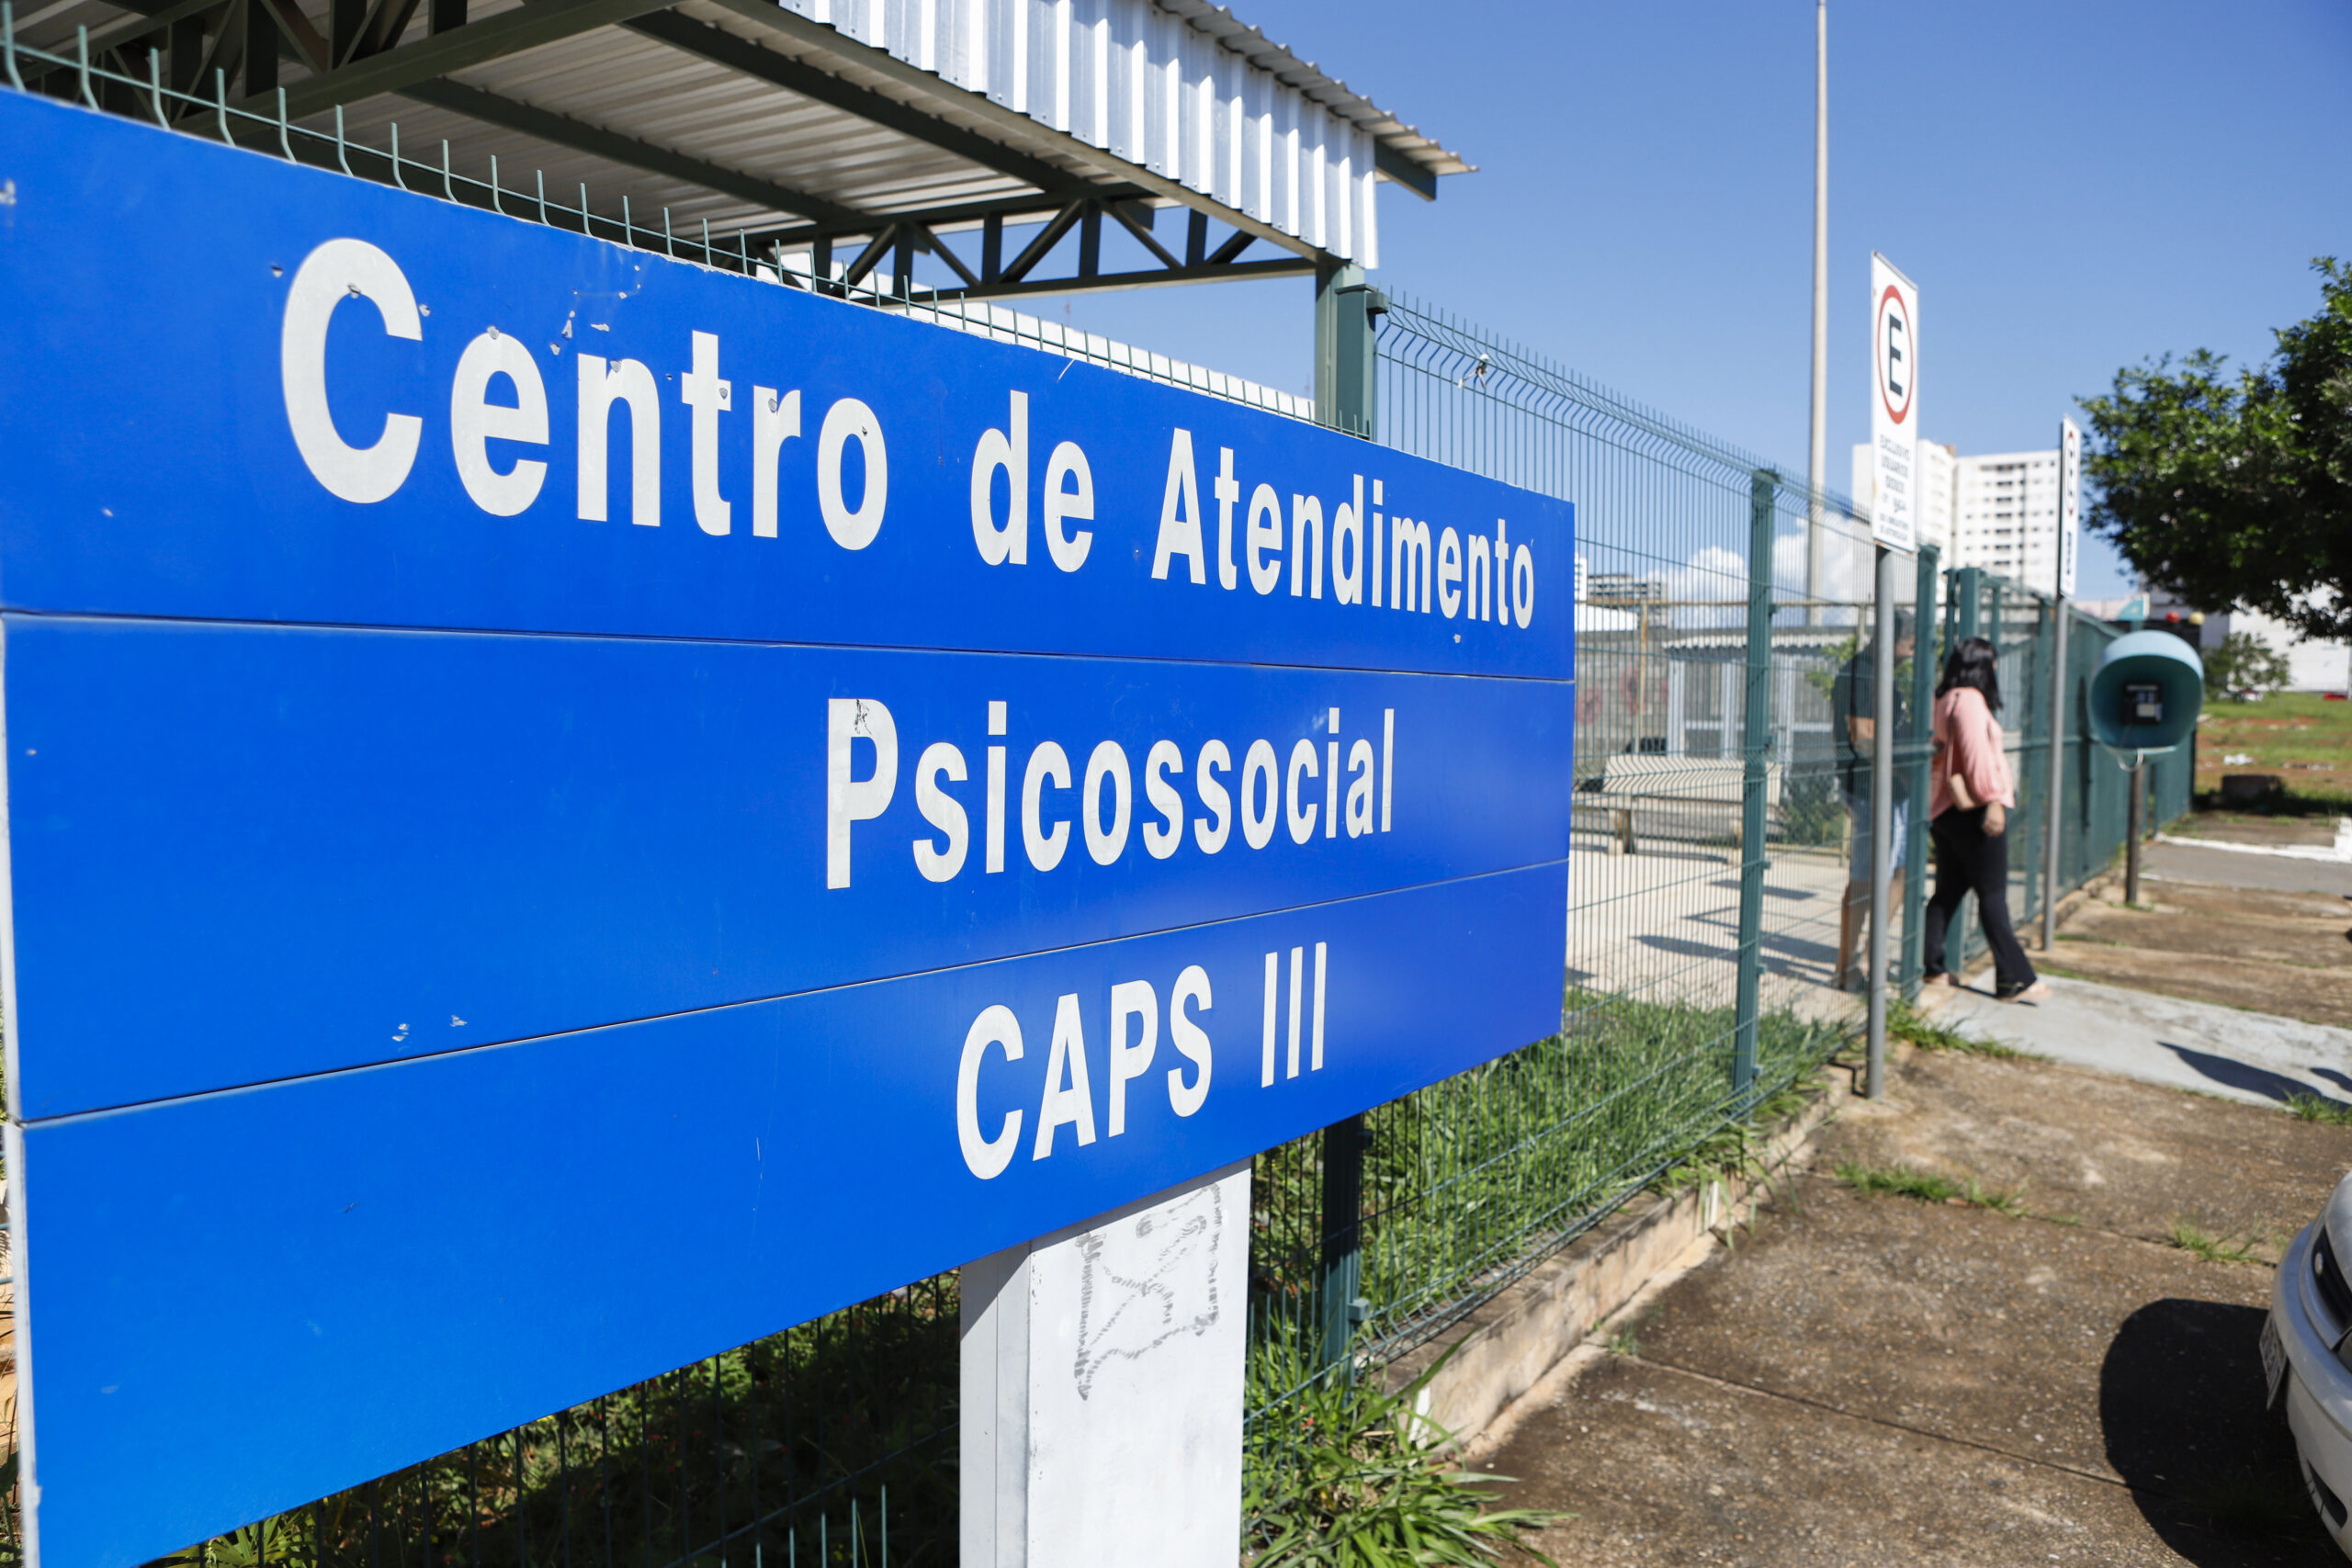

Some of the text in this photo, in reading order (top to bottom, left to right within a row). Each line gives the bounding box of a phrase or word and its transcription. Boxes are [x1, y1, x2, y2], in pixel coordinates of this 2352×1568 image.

[282, 238, 1534, 629] Centro de Atendimento
[1889, 313, 1902, 397] E
[827, 699, 1395, 890] Psicossocial
[956, 942, 1328, 1180] CAPS III
